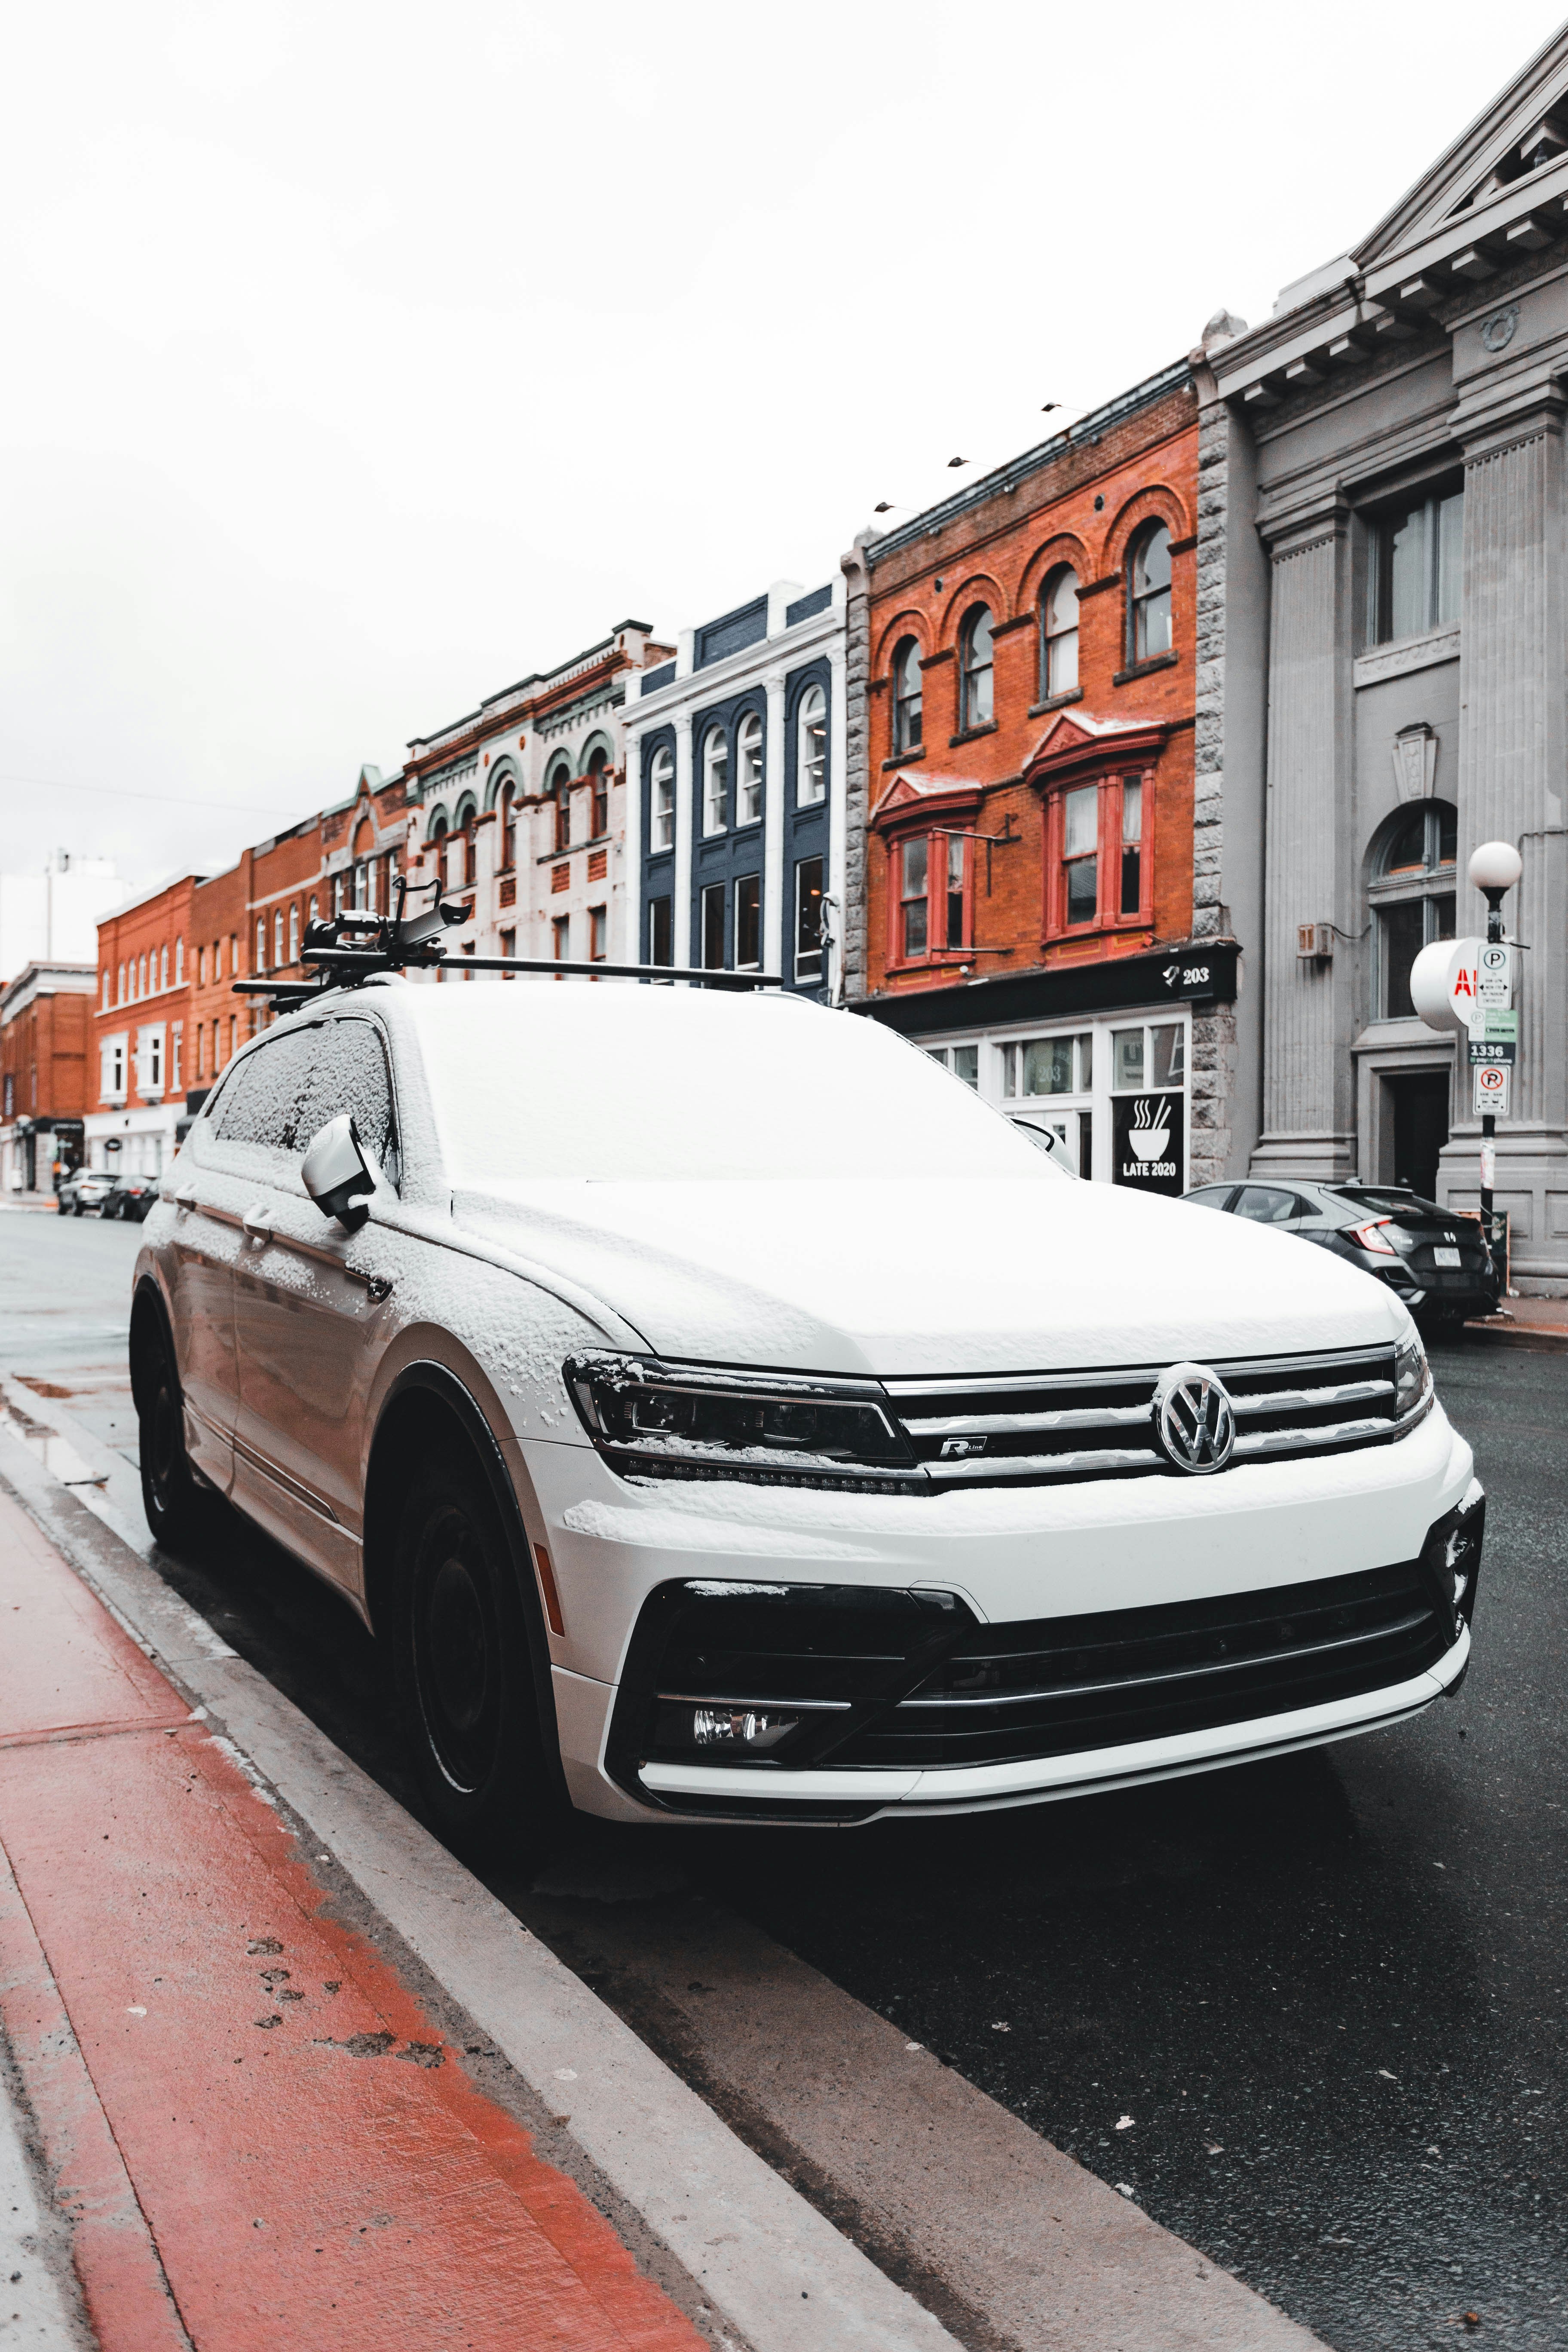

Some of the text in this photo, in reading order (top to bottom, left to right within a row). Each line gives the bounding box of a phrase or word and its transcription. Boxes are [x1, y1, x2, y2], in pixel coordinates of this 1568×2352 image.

[1490, 953, 1501, 965] P
[1183, 967, 1209, 985] 203
[1471, 1045, 1504, 1057] 1336
[1488, 1073, 1498, 1085] P
[1123, 1162, 1176, 1176] LATE 2020
[939, 1440, 969, 1457] R
